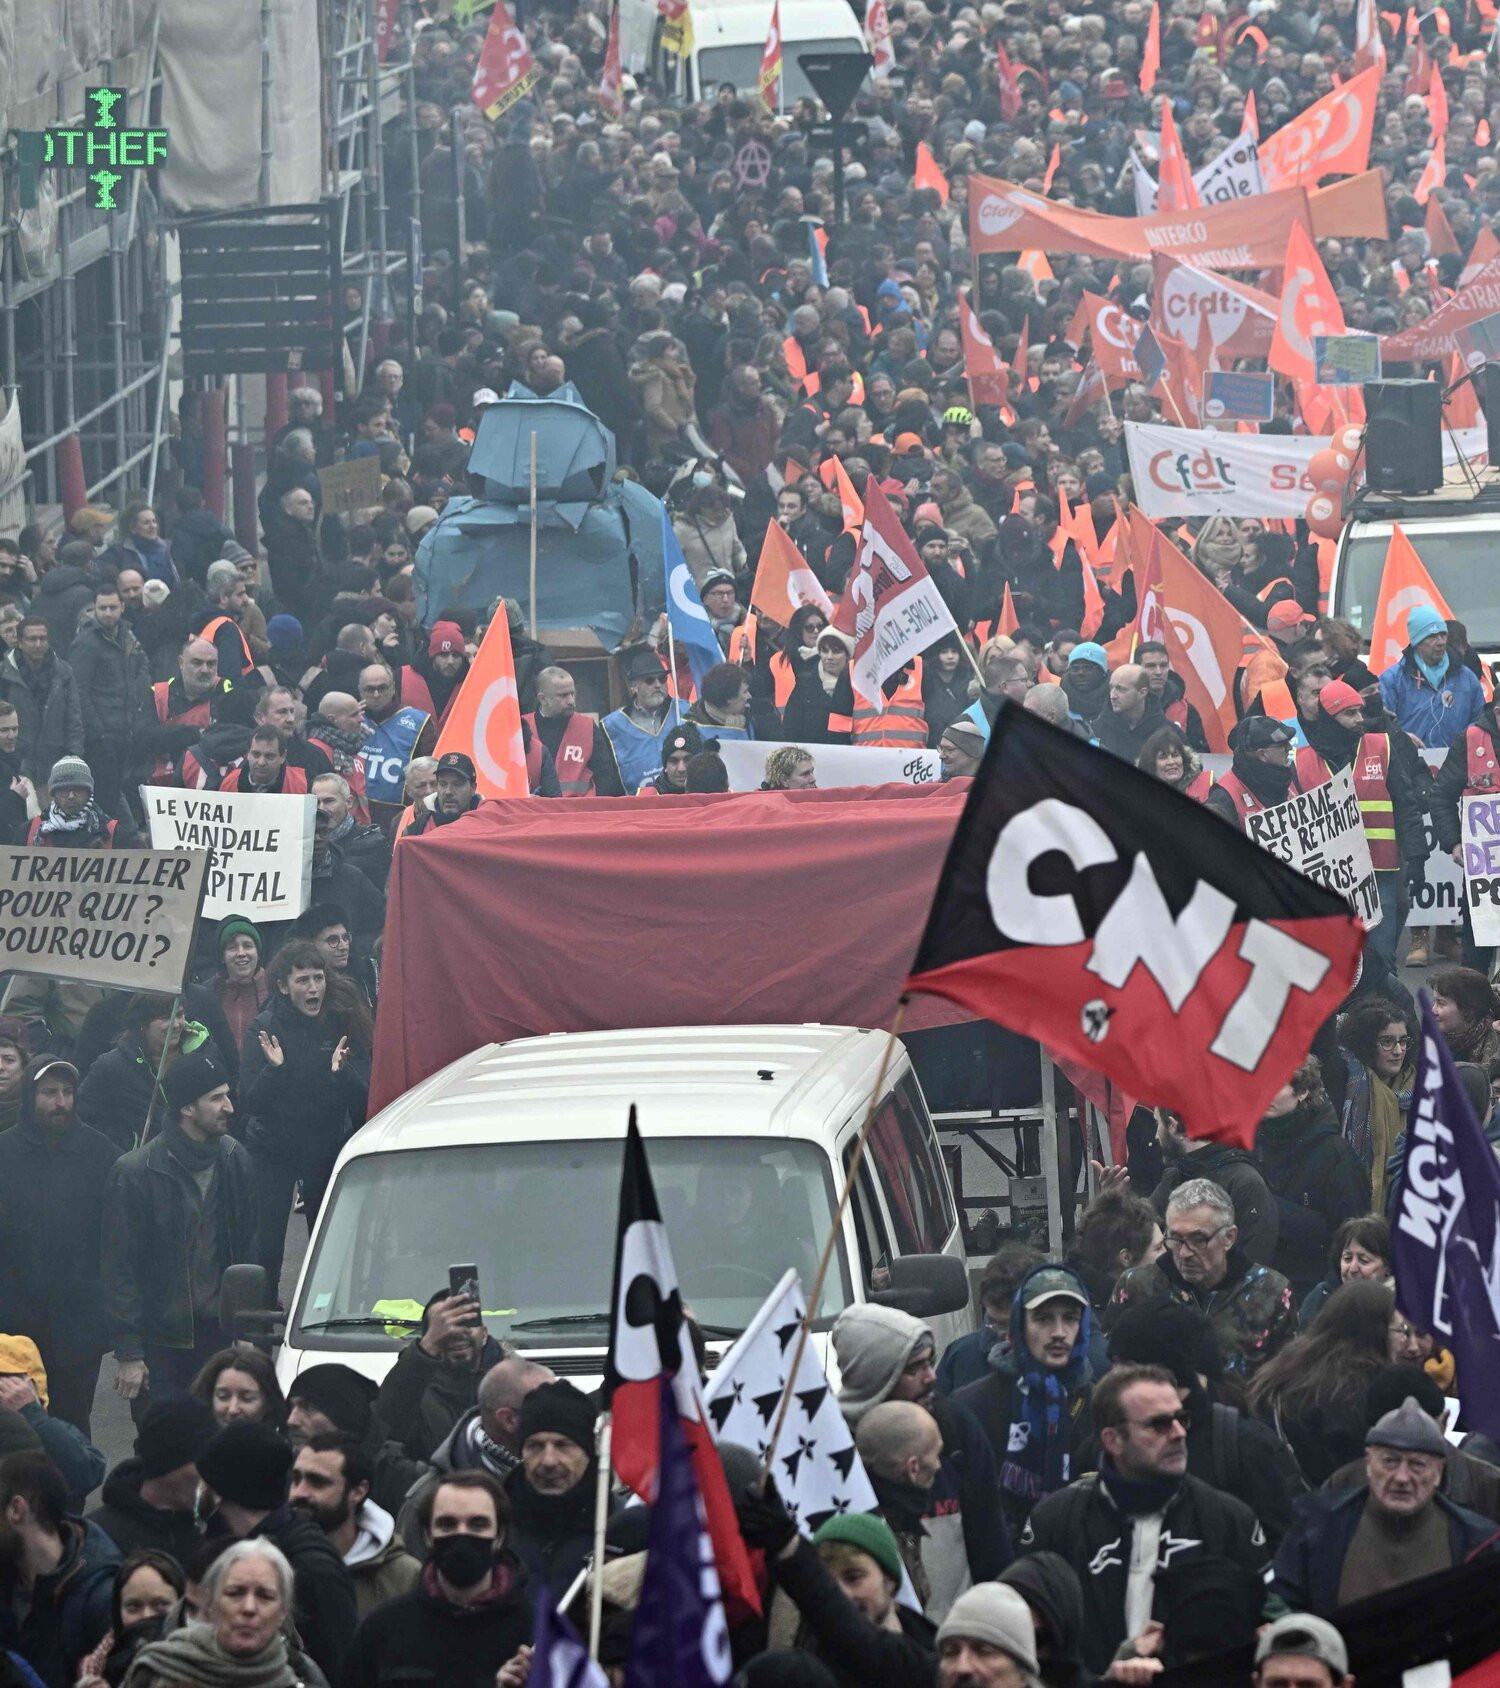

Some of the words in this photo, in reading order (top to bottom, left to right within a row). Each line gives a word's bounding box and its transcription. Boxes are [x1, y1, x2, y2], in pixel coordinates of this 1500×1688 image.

[1143, 220, 1208, 248] INTERCO
[441, 640, 452, 650] FO
[902, 756, 923, 778] CFE
[912, 763, 934, 785] CGC
[156, 799, 177, 816] LE
[184, 800, 233, 824] VRAI
[1248, 781, 1337, 845] REFORME
[174, 819, 281, 853] VANDALE
[1267, 836, 1294, 865] ES
[9, 855, 192, 891] TRAVAILLER
[78, 892, 137, 922] QUI
[986, 797, 1332, 1074] CNT
